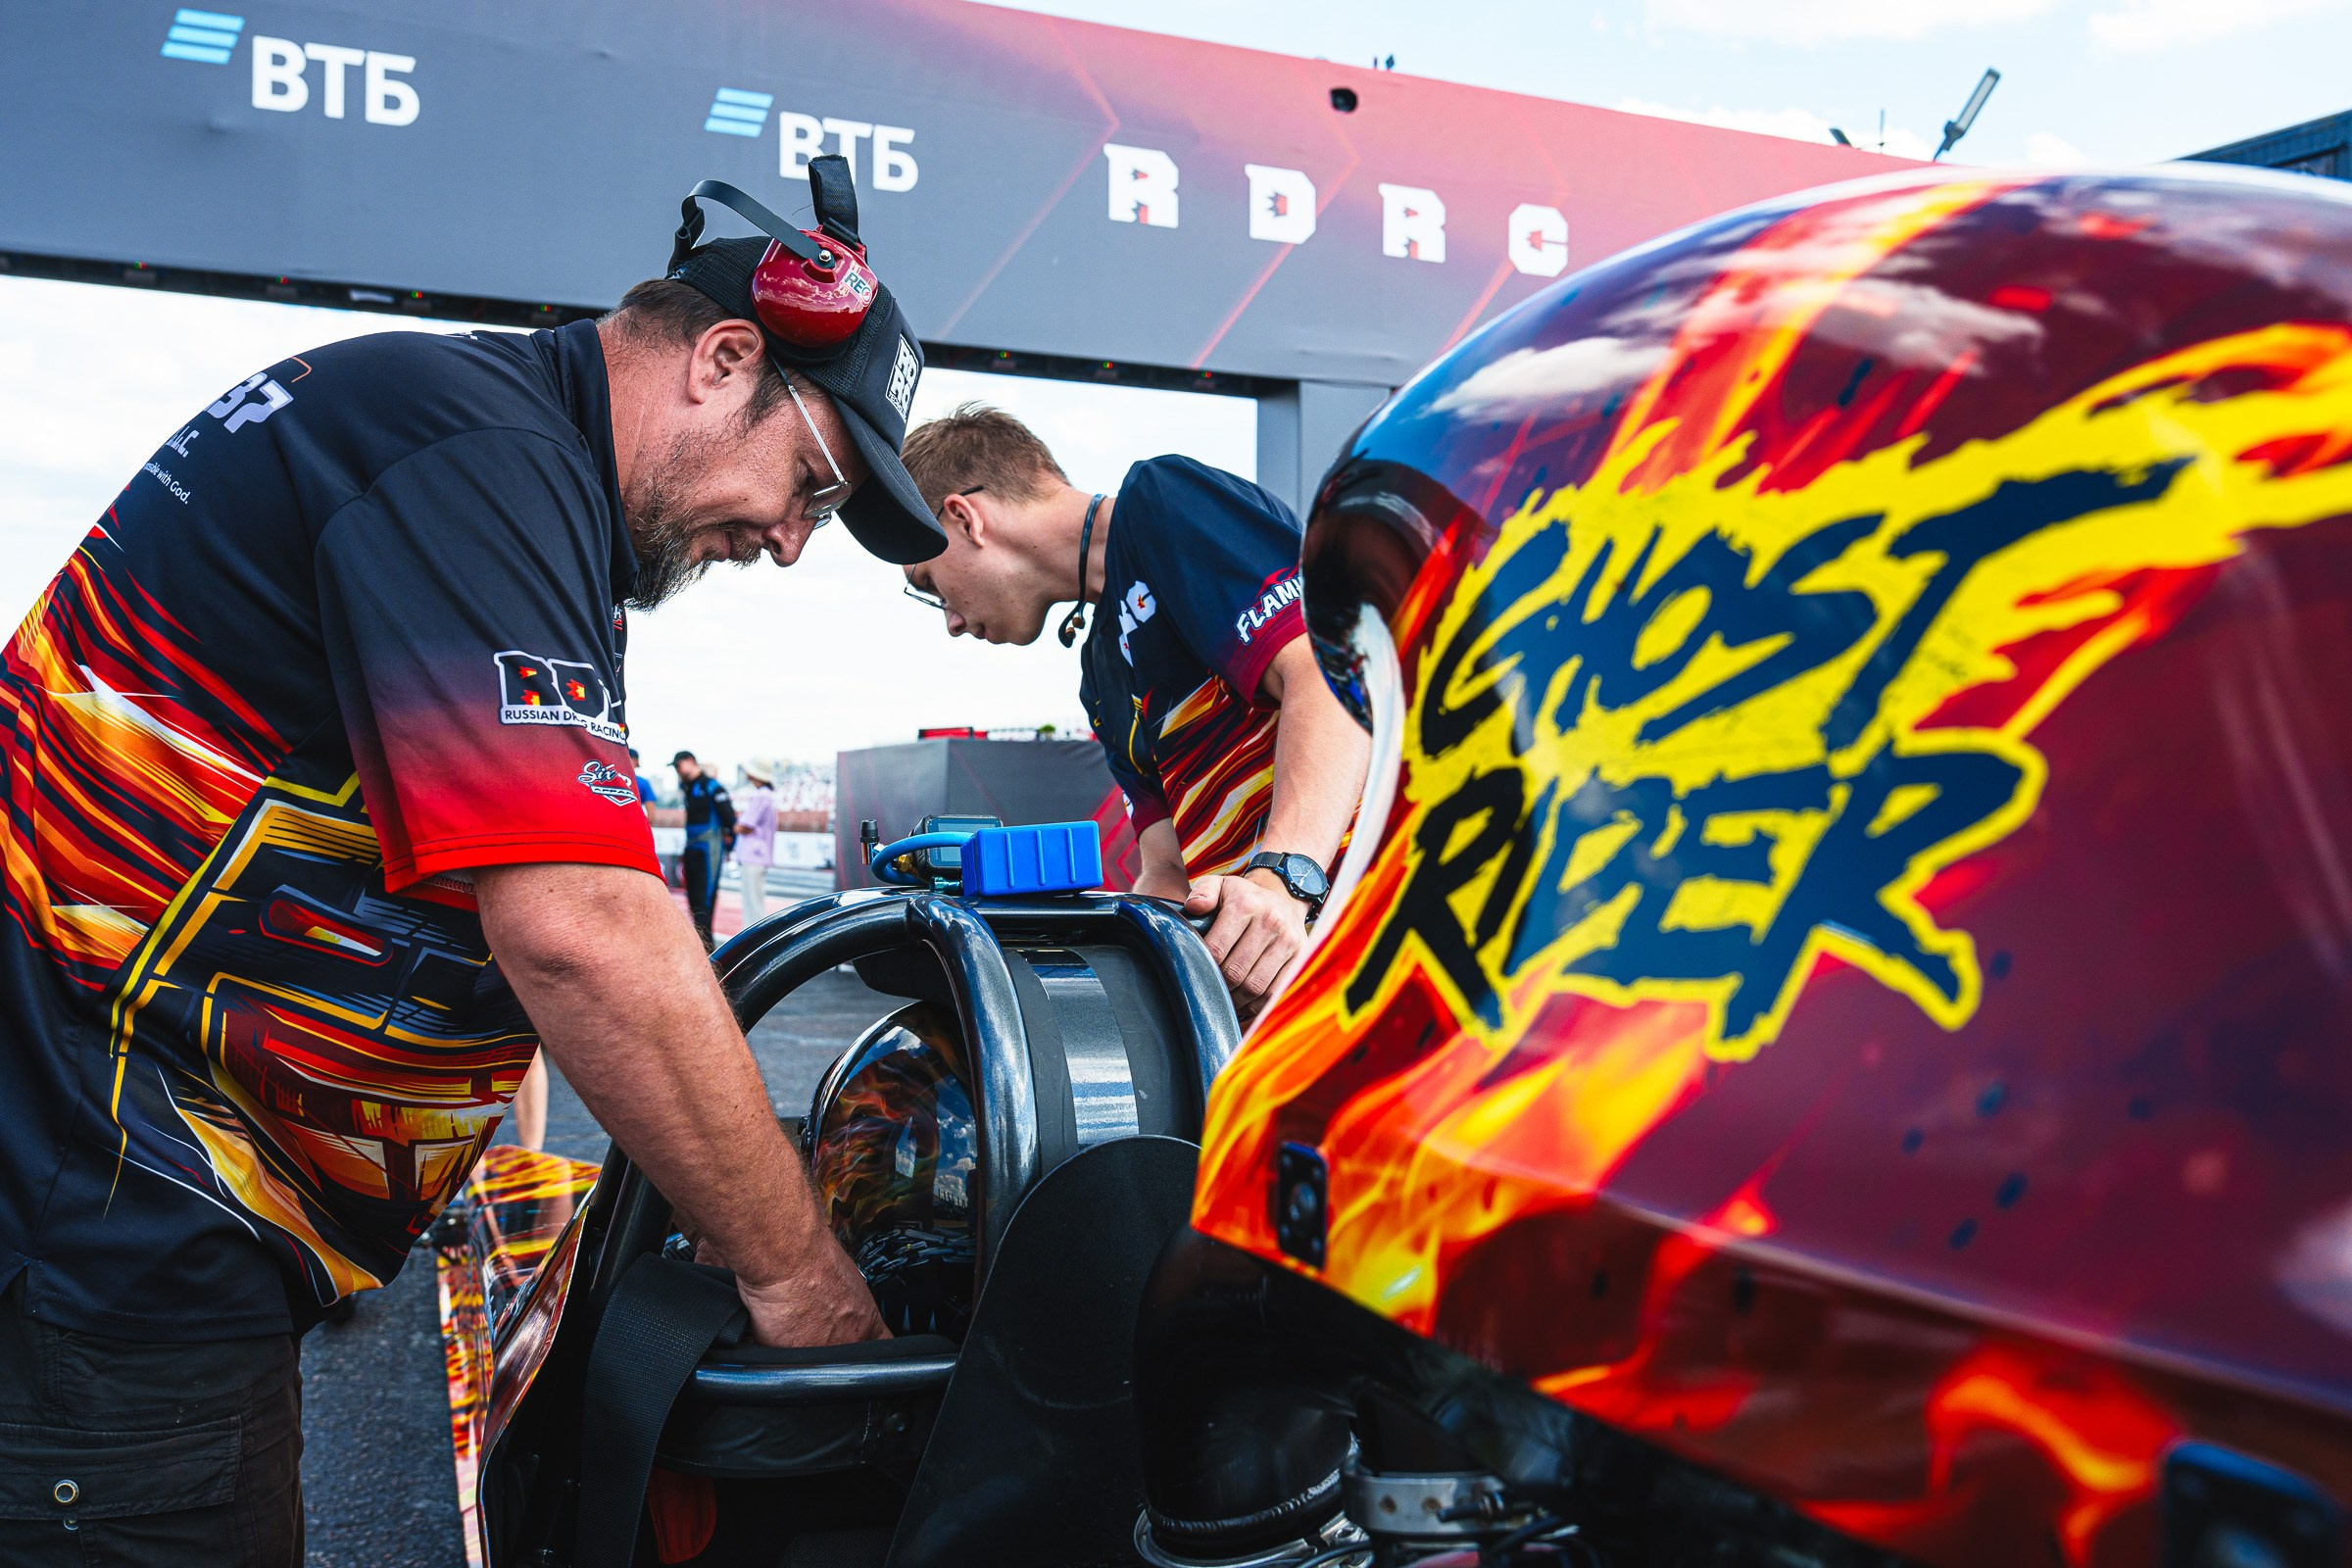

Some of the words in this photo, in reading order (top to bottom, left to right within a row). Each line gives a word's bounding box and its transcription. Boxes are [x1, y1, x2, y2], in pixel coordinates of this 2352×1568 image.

[253, 36, 420, 126] ВТБ
[779, 112, 919, 193] ВТБ
[156, 469, 172, 487] with
[170, 480, 191, 505] God.
[1421, 453, 2200, 760] GHOST
[505, 710, 560, 721] RUSSIAN
[564, 710, 588, 729] DRG
[1345, 750, 2025, 1041] RIDER
